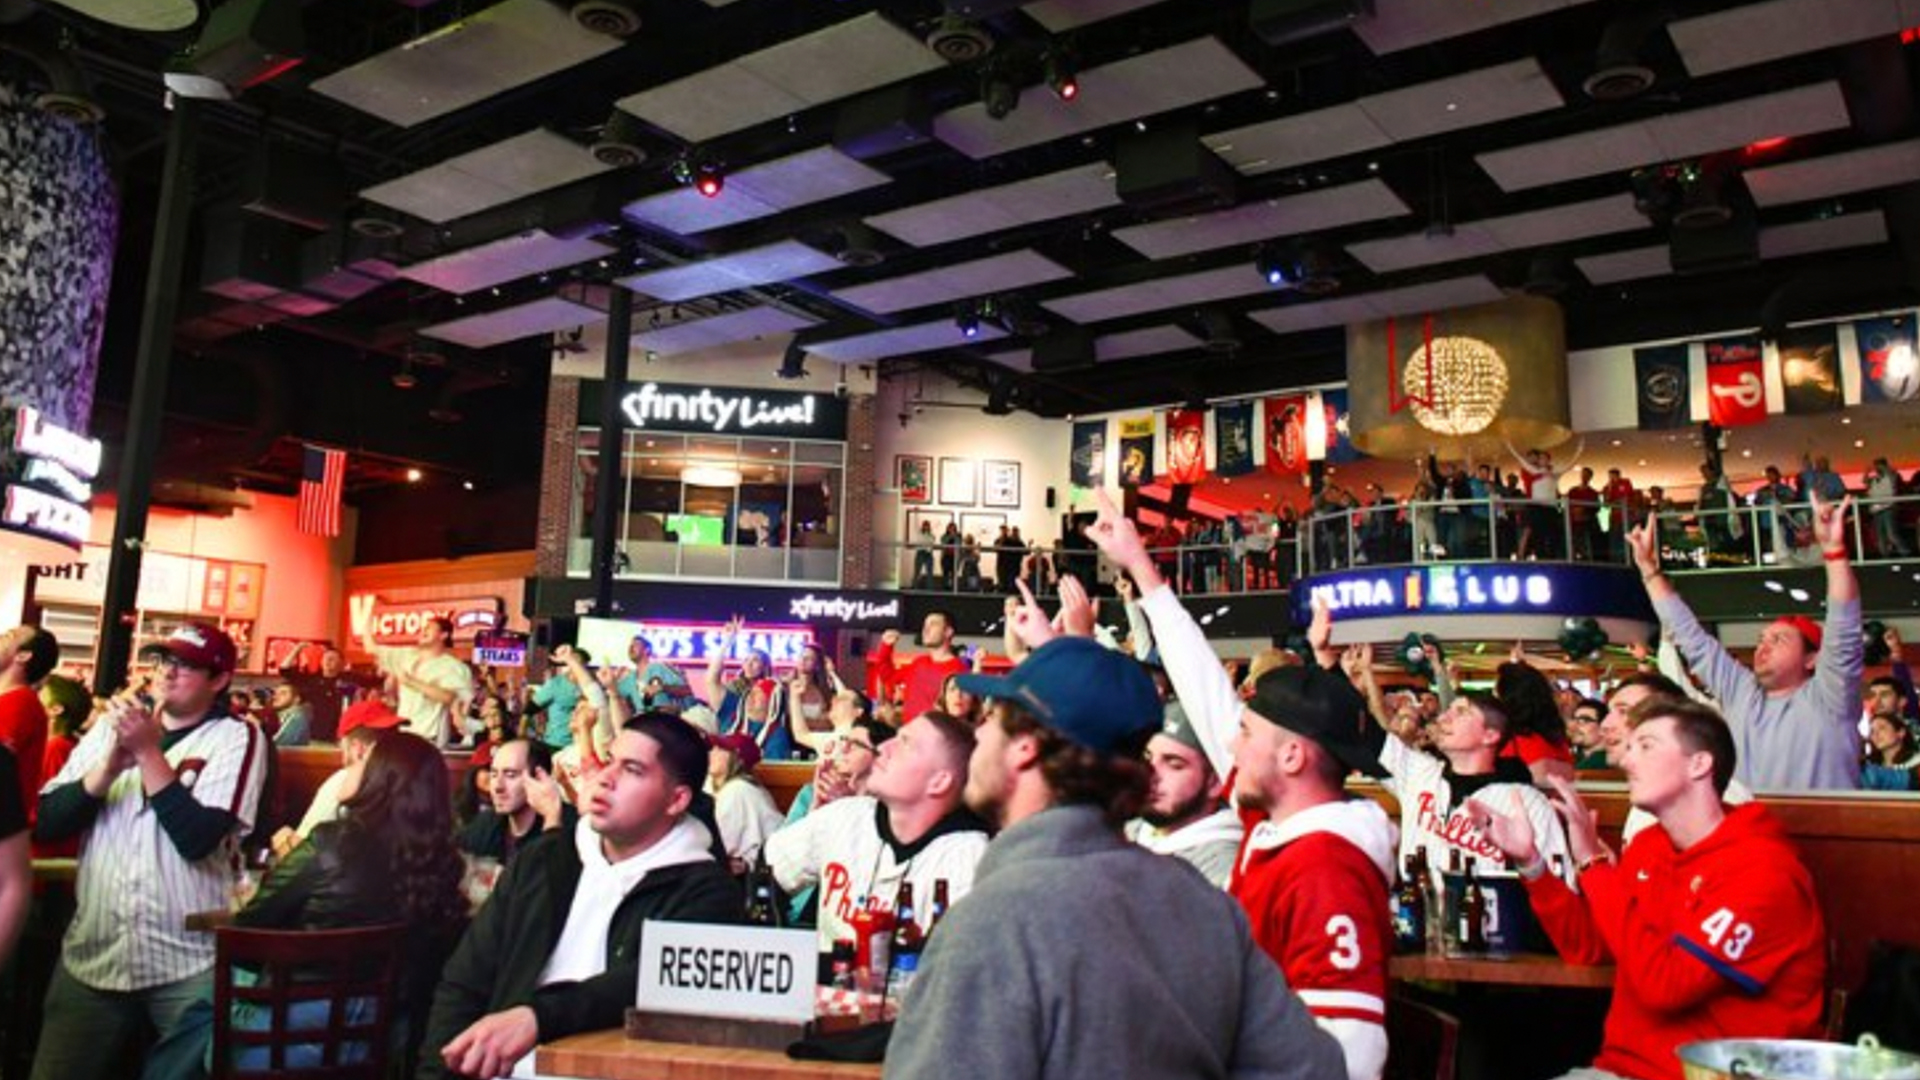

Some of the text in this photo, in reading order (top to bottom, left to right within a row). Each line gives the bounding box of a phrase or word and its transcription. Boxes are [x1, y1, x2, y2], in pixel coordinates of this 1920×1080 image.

[790, 594, 856, 621] xfinity
[1434, 576, 1551, 605] CLUB
[1325, 915, 1363, 971] 3
[1701, 907, 1755, 960] 43
[659, 946, 794, 994] RESERVED
